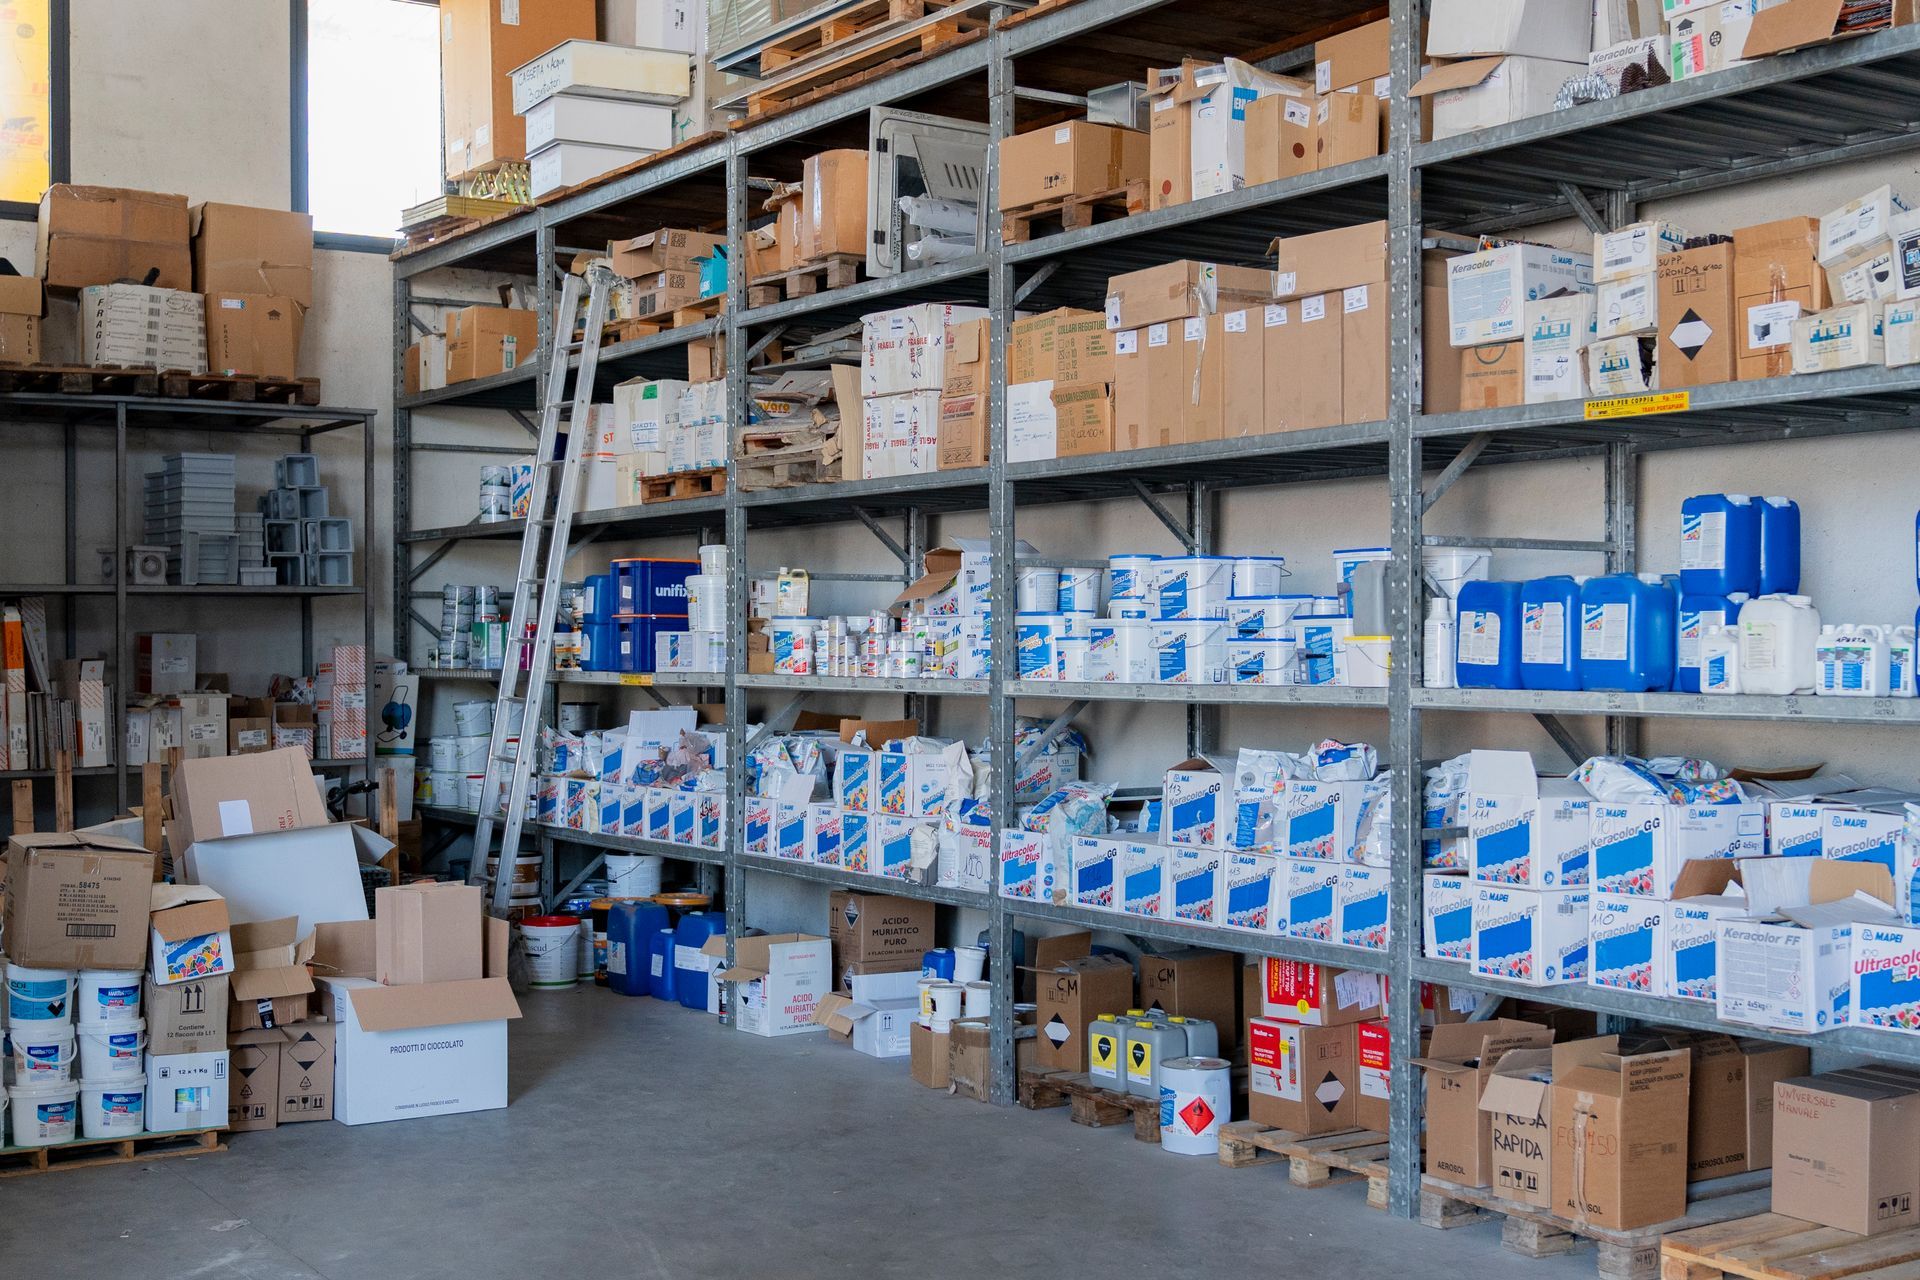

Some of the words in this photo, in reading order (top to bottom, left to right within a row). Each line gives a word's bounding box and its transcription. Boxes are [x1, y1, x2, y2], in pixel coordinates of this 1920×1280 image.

[1452, 258, 1495, 275] Keracolor
[1252, 608, 1266, 620] WPS
[1252, 650, 1266, 662] WPS
[1015, 766, 1049, 792] Ultracolor
[1036, 773, 1052, 787] Plus
[1168, 790, 1207, 808] Keracolor
[1208, 782, 1221, 795] GG
[1300, 785, 1317, 793] MAPEI
[1287, 800, 1326, 820] Keracolor
[1327, 792, 1340, 806] GG
[1606, 808, 1628, 819] MAPEI
[1698, 809, 1718, 818] MAPEI
[1792, 807, 1819, 819] MAPEI
[1472, 817, 1518, 839] Keracolor
[1522, 809, 1536, 824] FF
[1843, 818, 1868, 829] MAPEI
[1590, 825, 1642, 849] Keracolor
[1643, 816, 1661, 832] GG
[1728, 839, 1741, 853] GG
[1826, 835, 1882, 860] Keracolor
[1886, 828, 1901, 845] FF
[1001, 843, 1038, 862] Ultracolor
[1024, 852, 1041, 864] Plus
[1074, 852, 1106, 870] Keracolor
[1107, 847, 1118, 859] GG
[1238, 856, 1256, 866] MAPEI
[1172, 865, 1207, 883] Keracolor
[1207, 859, 1219, 872] GG
[1299, 865, 1316, 875] MAPEI
[1353, 870, 1370, 881] MAPEI
[1226, 872, 1265, 890] Keracolor
[1266, 866, 1277, 879] FF
[79, 881, 101, 890] 58475
[1287, 882, 1326, 899] Keracolor
[1325, 875, 1338, 888] GG
[1441, 880, 1462, 891] MAPEI
[1341, 888, 1380, 906] Keracolor
[1489, 893, 1509, 903] MAPEI
[1606, 902, 1629, 913] MAPEI
[882, 916, 910, 926] ACIDO
[1475, 910, 1521, 931] Keracolor
[1523, 904, 1538, 918] FF
[1685, 910, 1709, 921] MAPEI
[872, 926, 920, 937] MURIATICO
[1590, 921, 1641, 942] Keracolor
[1643, 914, 1661, 929] GG
[883, 937, 908, 947] PURO
[1723, 927, 1783, 945] Keracolor
[1784, 934, 1801, 947] FF
[1875, 931, 1904, 944] MAPEI
[1157, 967, 1176, 984] CM
[1057, 977, 1078, 997] CM
[792, 992, 813, 1004] ACIDO
[174, 1031, 196, 1039] flaconi
[196, 1030, 205, 1038] da
[178, 1024, 205, 1032] Contiene
[390, 1044, 420, 1055] PRODOTTI
[420, 1043, 427, 1052] DI
[427, 1039, 464, 1051] CIOCCOLATO
[199, 1067, 208, 1075] Kg
[1629, 1069, 1642, 1077] KEEP
[1642, 1066, 1663, 1075] UPRIGHT
[1629, 1085, 1651, 1093] VERTICAL
[1777, 1085, 1837, 1109] UNIVERSALE
[1777, 1100, 1820, 1119] MANUALE
[1494, 1128, 1544, 1161] RAPIDA
[1697, 1156, 1724, 1170] AEROSOL
[1725, 1152, 1745, 1165] DOSEN
[1437, 1160, 1466, 1176] AEROSOL
